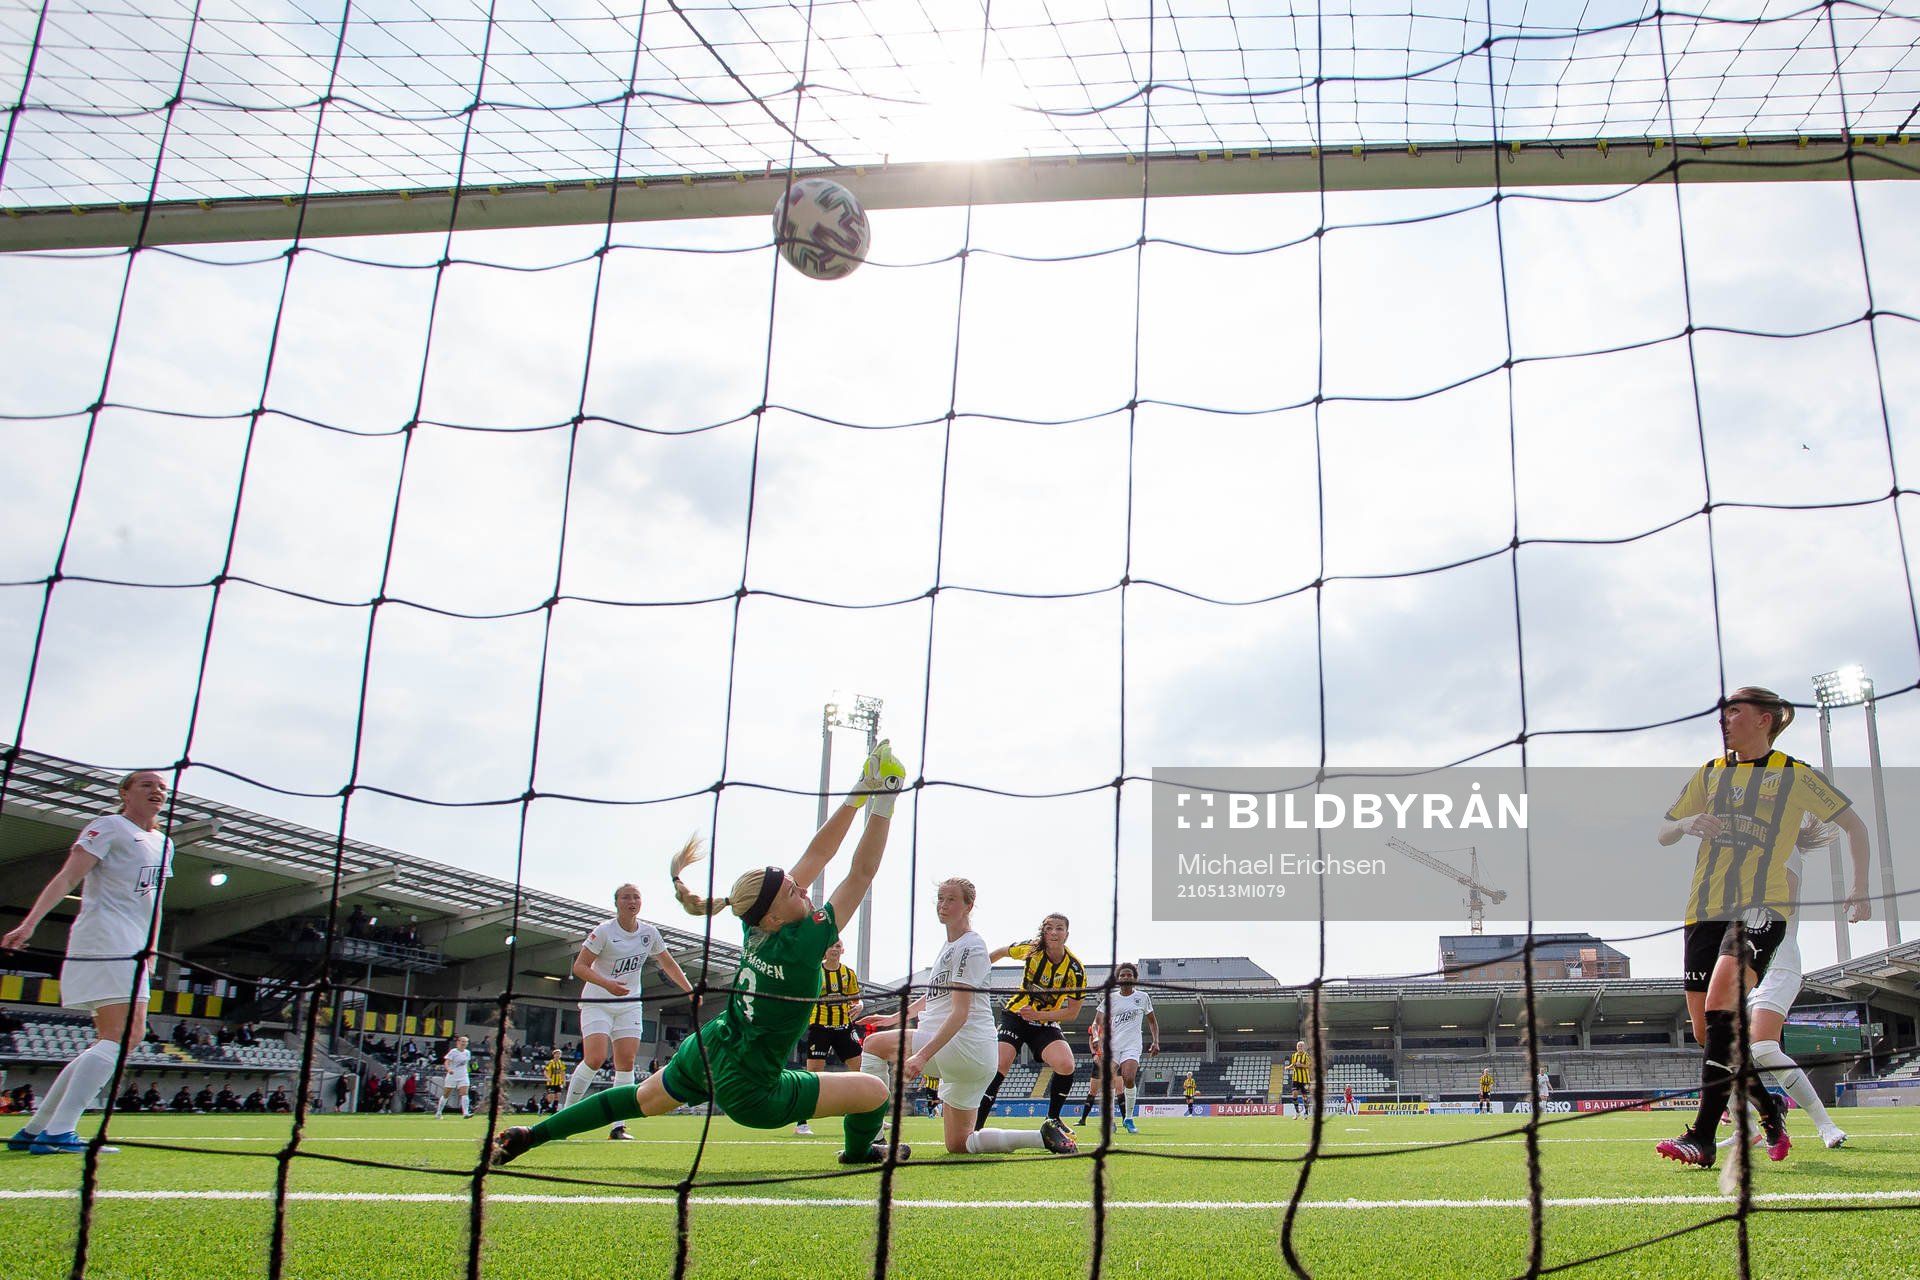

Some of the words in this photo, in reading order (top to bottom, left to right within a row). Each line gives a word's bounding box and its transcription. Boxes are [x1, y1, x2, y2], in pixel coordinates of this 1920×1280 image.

[1800, 774, 1838, 811] stadium
[615, 957, 639, 973] JAG
[1218, 1104, 1276, 1113] BAUHAUS
